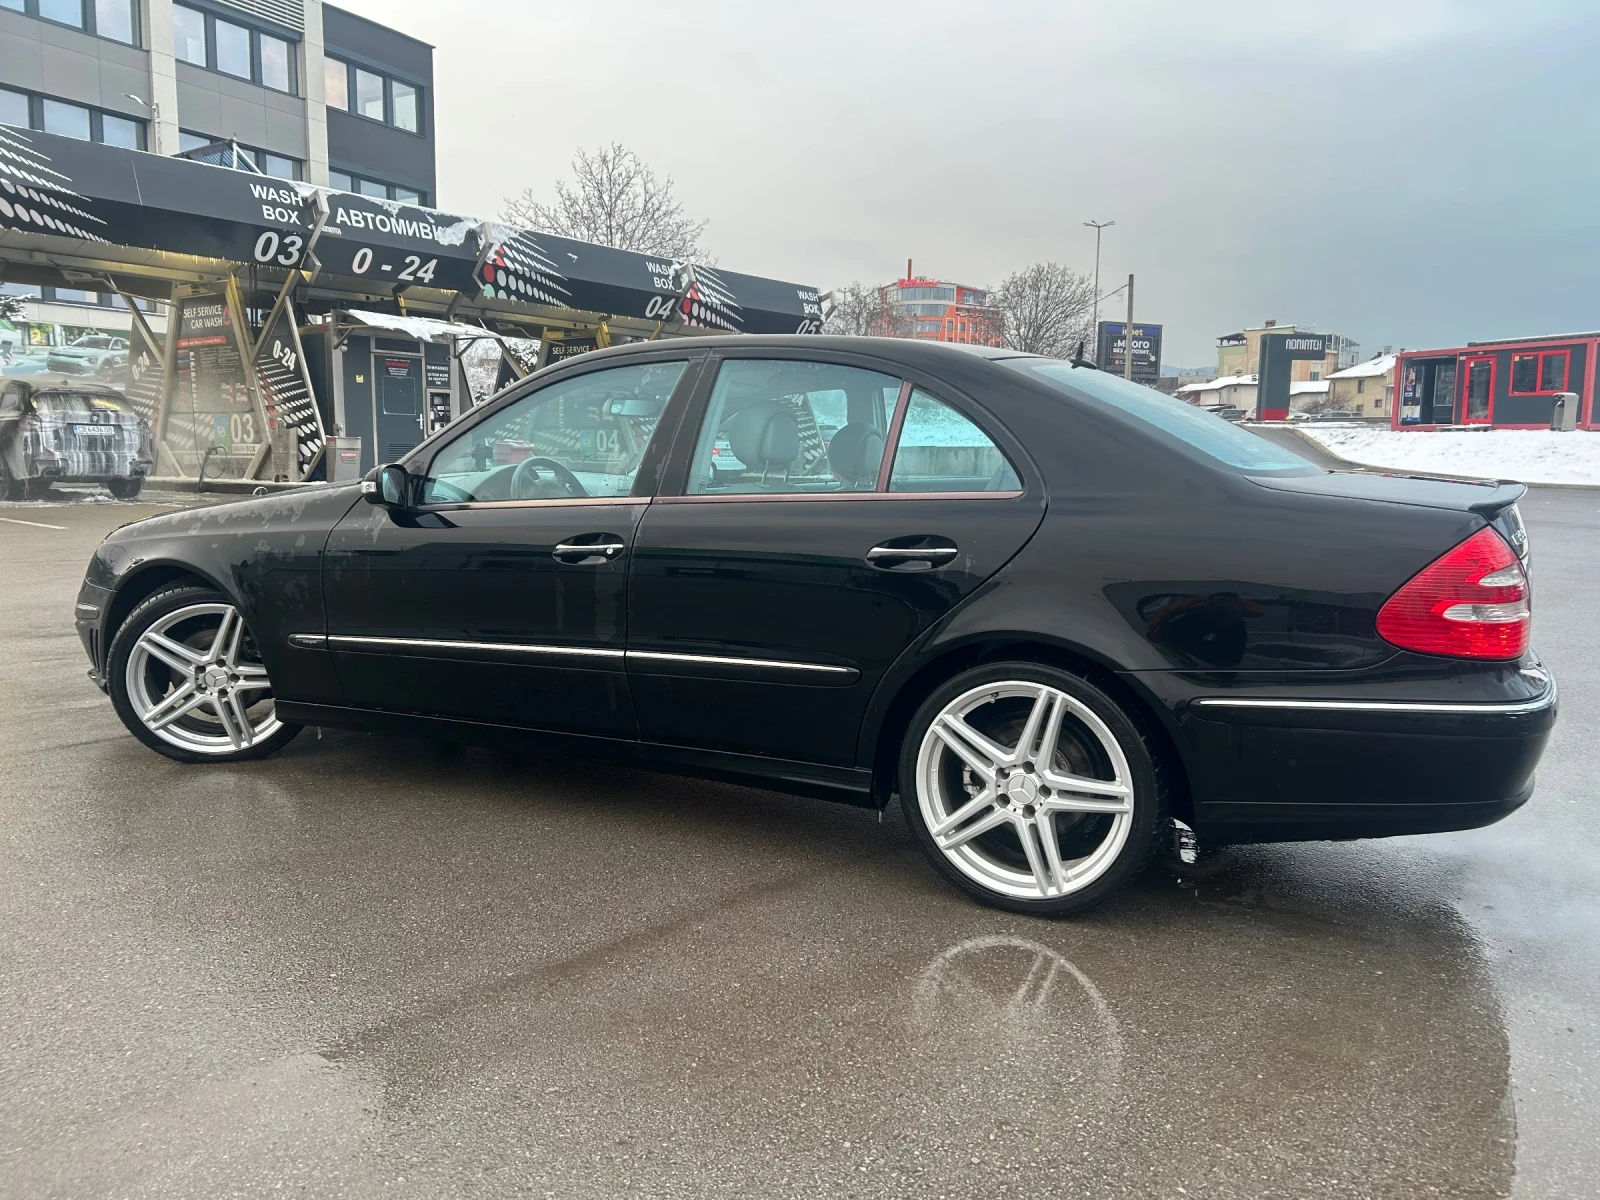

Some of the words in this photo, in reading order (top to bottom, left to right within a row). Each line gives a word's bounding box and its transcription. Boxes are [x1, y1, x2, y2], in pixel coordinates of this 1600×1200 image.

[249, 183, 303, 207] WASH
[262, 205, 301, 225] BOX
[254, 231, 303, 266] 03
[352, 247, 373, 274] 0
[398, 255, 438, 283] 24
[653, 276, 676, 291] BOX
[797, 290, 819, 302] WASH
[183, 307, 197, 319] SELF
[197, 304, 222, 317] SERVICE
[645, 296, 676, 320] 04
[803, 302, 820, 315] BOX
[190, 319, 203, 329] CAR
[204, 317, 223, 328] WASH
[272, 339, 297, 371] 0-24
[552, 346, 566, 355] SELF
[566, 345, 590, 354] SERVICE
[131, 350, 150, 381] 0-24
[230, 413, 254, 443] 03
[596, 430, 620, 453] 04
